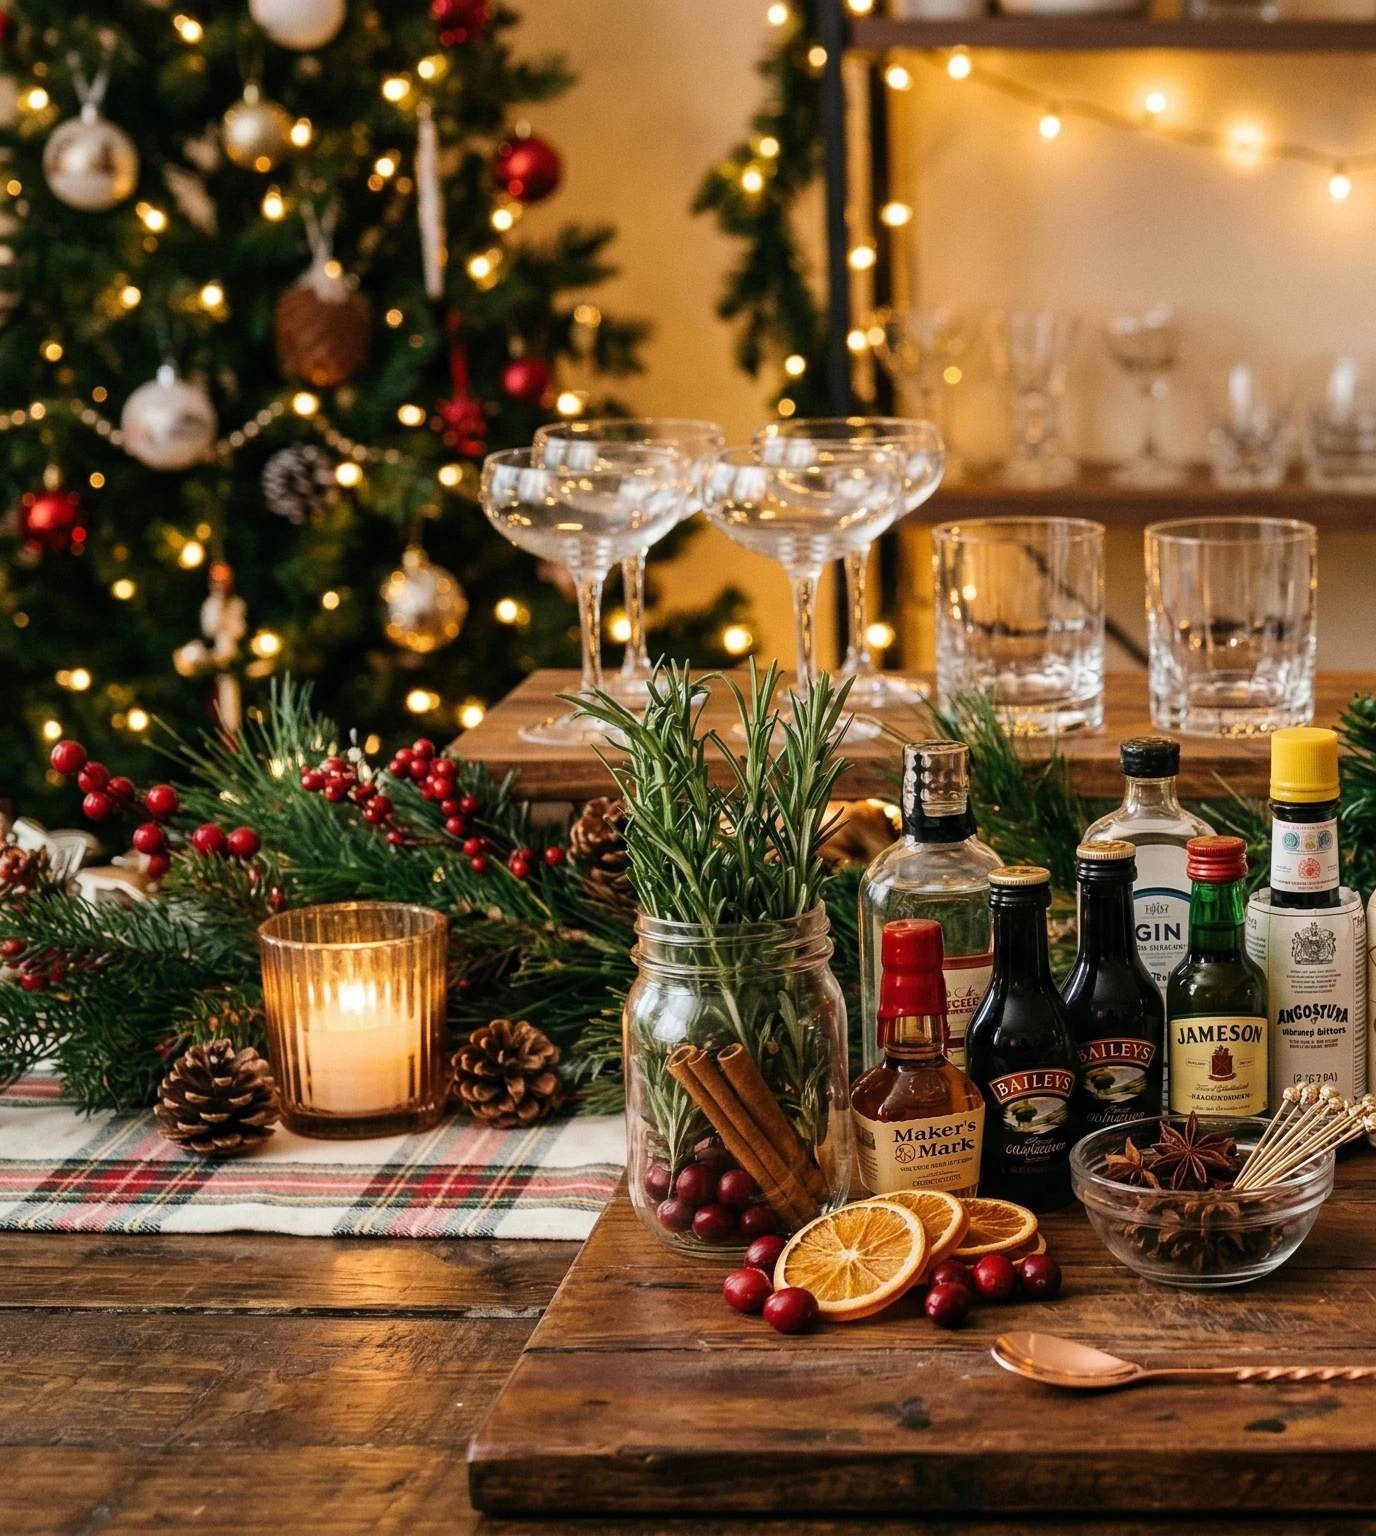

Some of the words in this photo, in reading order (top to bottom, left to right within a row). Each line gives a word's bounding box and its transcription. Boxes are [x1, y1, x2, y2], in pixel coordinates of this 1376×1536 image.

[1135, 922, 1181, 942] GIN
[1177, 1024, 1263, 1045] JAMESON
[1077, 1043, 1151, 1063] BAILEYS
[892, 1120, 977, 1143] Maker's
[917, 1137, 976, 1159] Mark
